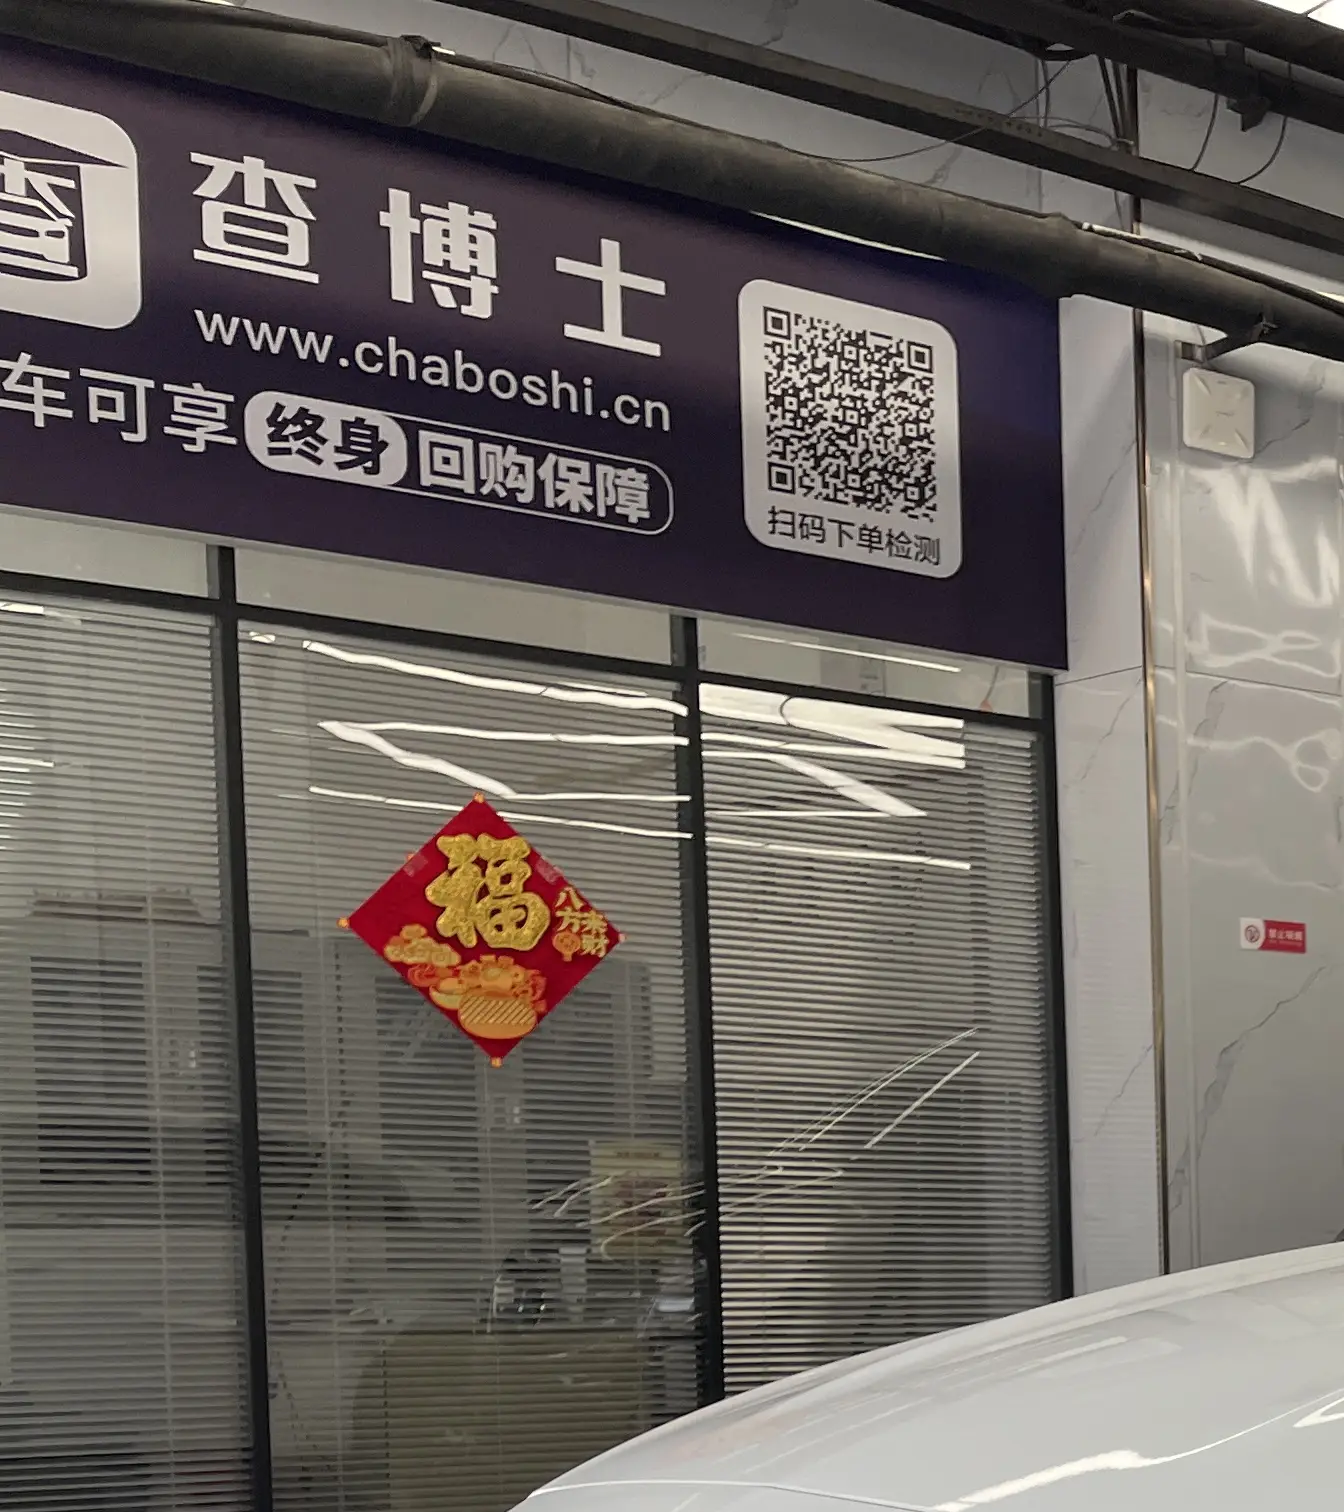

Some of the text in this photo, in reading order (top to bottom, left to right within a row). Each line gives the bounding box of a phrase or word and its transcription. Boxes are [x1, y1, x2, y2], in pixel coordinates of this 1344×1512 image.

[190, 152, 665, 356] 查博士
[194, 310, 670, 431] www.chaboshi.cn
[264, 402, 389, 476] 终身
[418, 430, 650, 523] 回购保障
[768, 506, 940, 565] 扫码下单检测
[425, 833, 550, 951] 福
